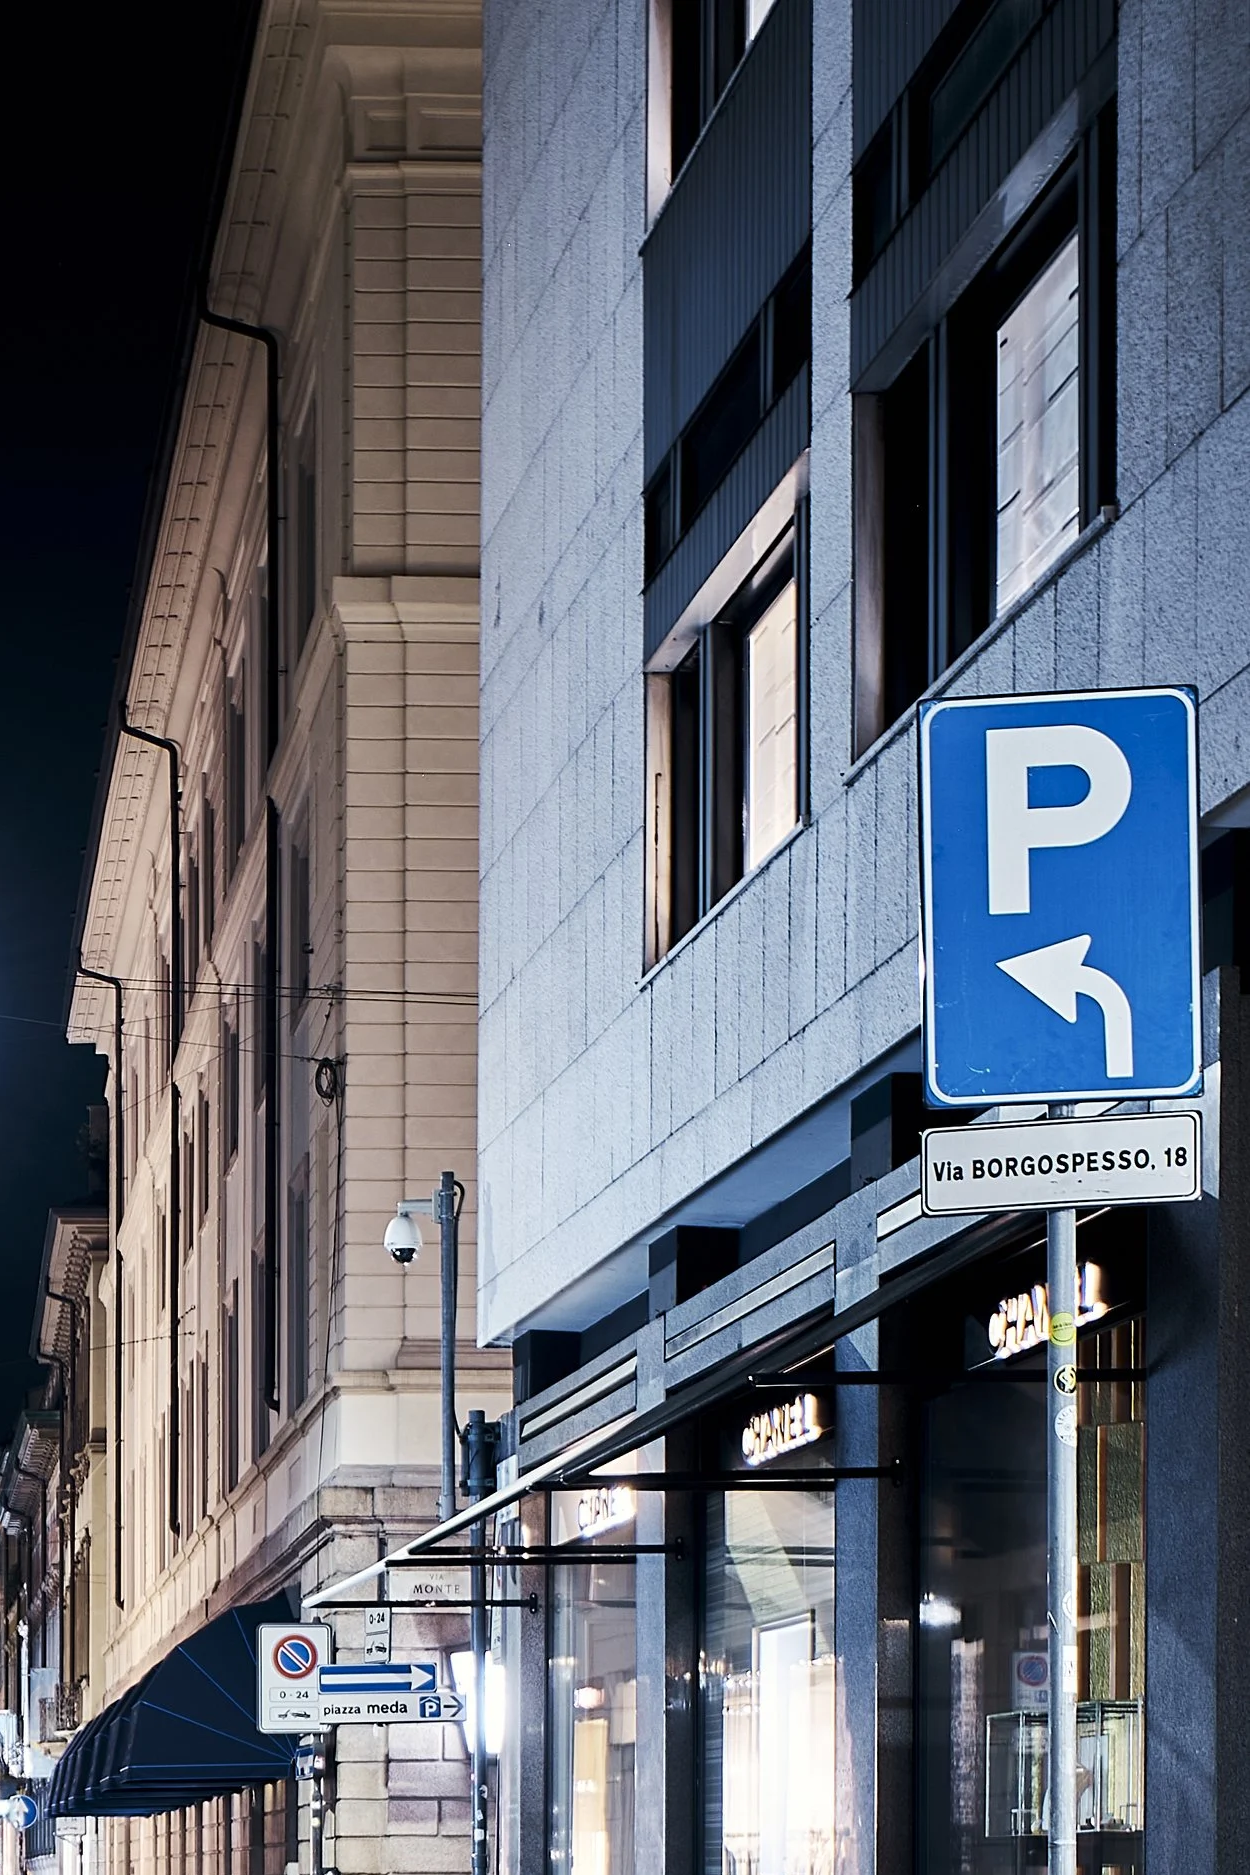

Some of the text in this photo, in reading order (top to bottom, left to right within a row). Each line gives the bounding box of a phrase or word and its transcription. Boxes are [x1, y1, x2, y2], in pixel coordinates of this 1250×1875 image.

[986, 724, 1132, 915] P
[933, 1160, 964, 1182] Via
[1163, 1146, 1188, 1169] 18
[988, 1261, 1109, 1359] CHANL
[742, 1393, 823, 1466] CHANEL
[413, 1584, 461, 1594] MONTE
[429, 1573, 445, 1581] VIA
[295, 1690, 309, 1699] 24
[323, 1704, 361, 1716] piazza
[367, 1700, 408, 1714] meda
